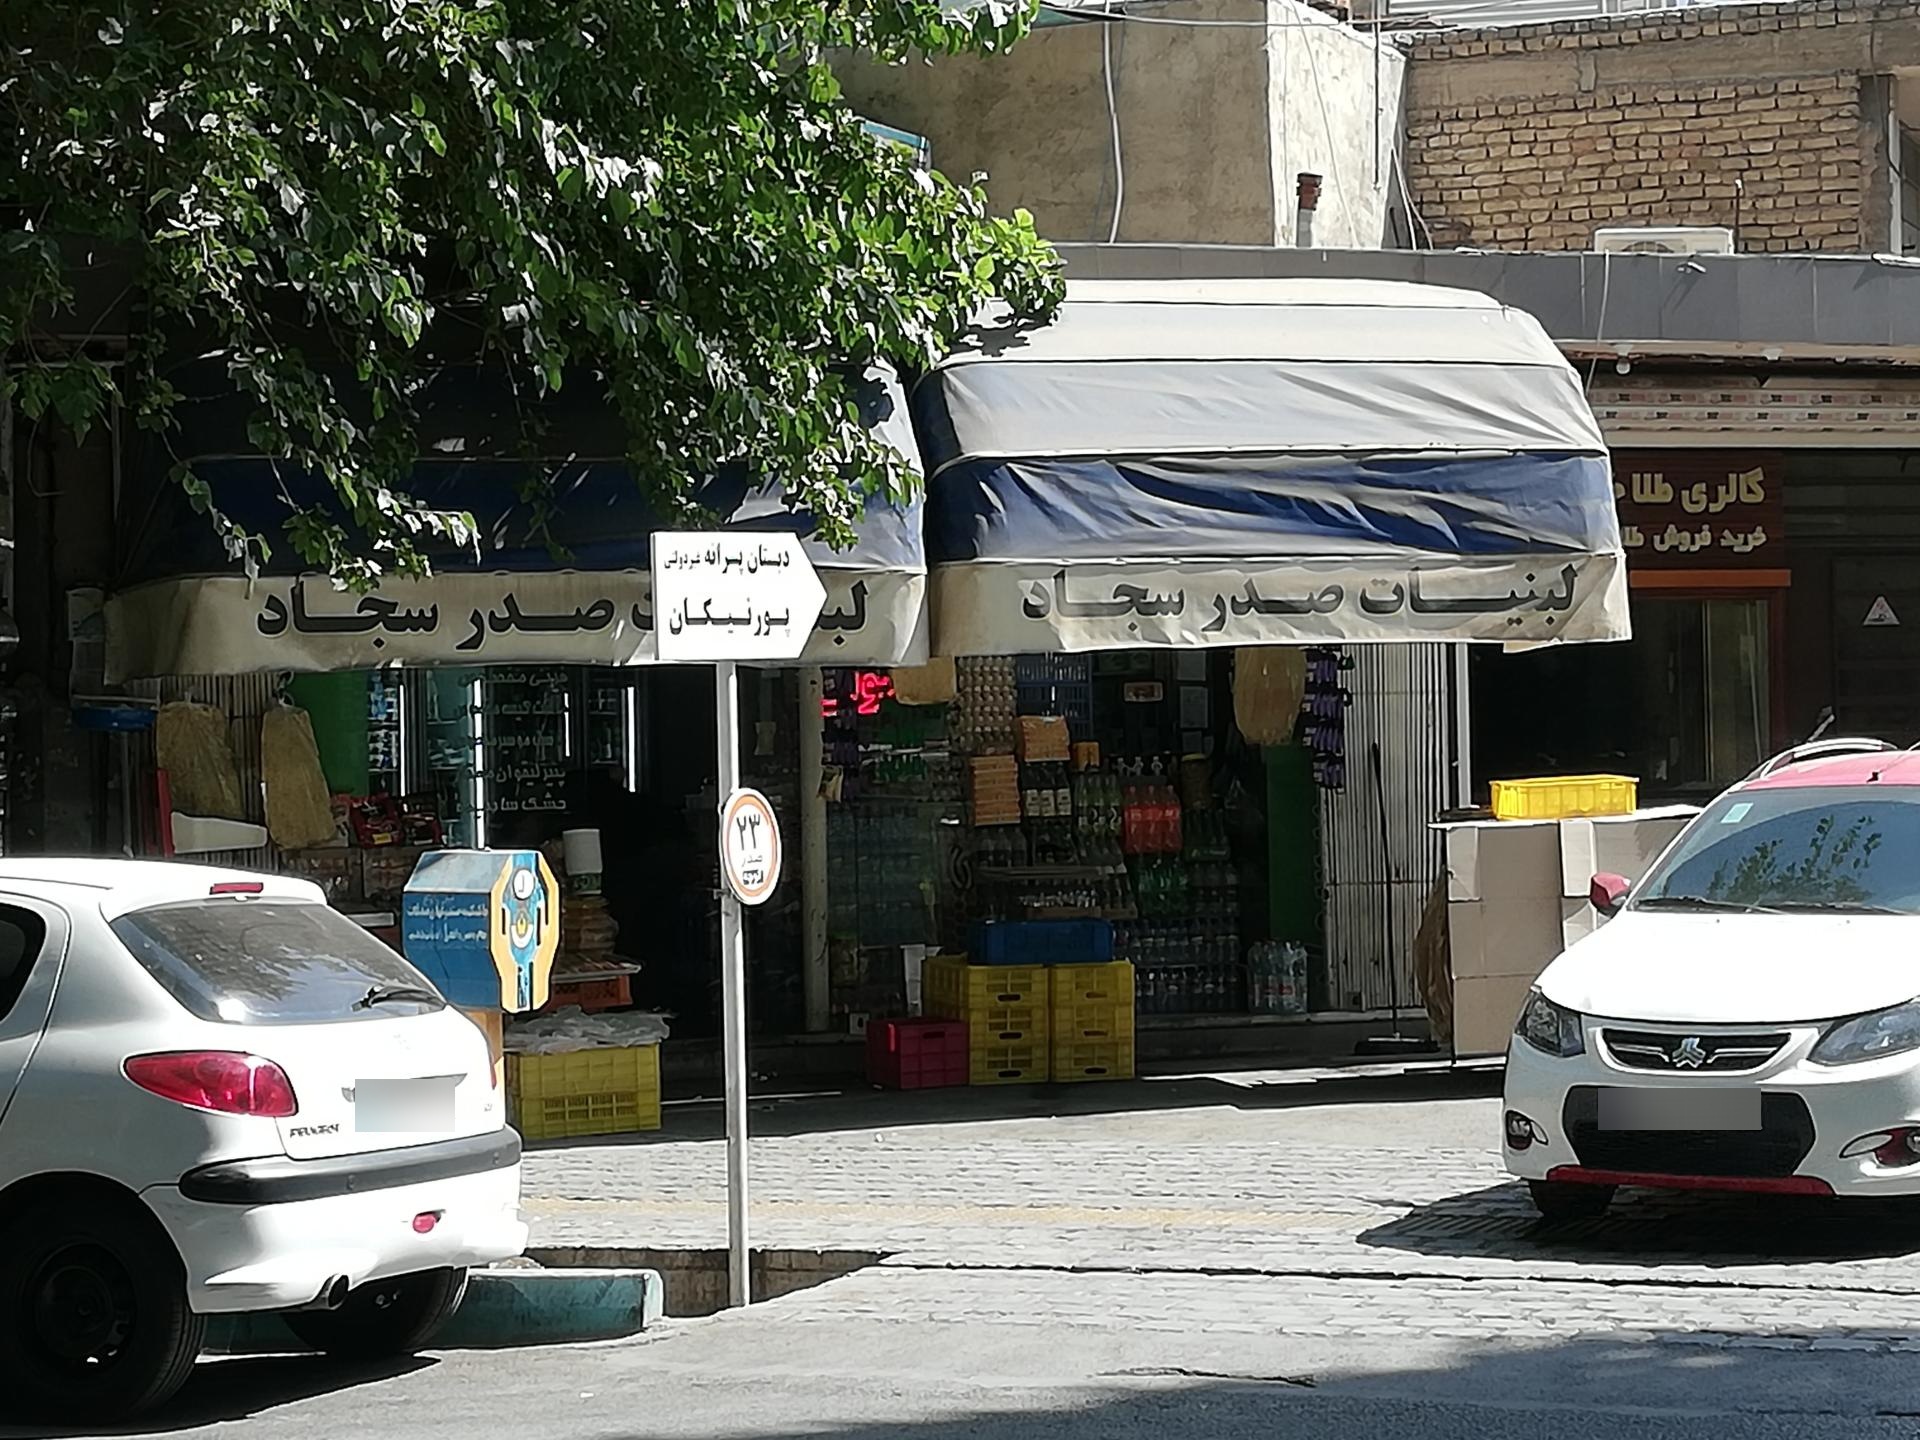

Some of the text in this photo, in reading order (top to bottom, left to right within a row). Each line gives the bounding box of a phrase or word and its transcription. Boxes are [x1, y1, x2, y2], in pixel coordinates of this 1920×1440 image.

[1631, 472, 1674, 504] طلا
[1652, 522, 1712, 553] فروش
[1719, 525, 1768, 553] خرید
[256, 581, 439, 648] سجاد
[669, 596, 791, 638] پورنیکان
[1021, 562, 1582, 636] لبنیات صدر سجاد
[454, 592, 616, 651] صدر
[736, 813, 761, 851] ۲۳
